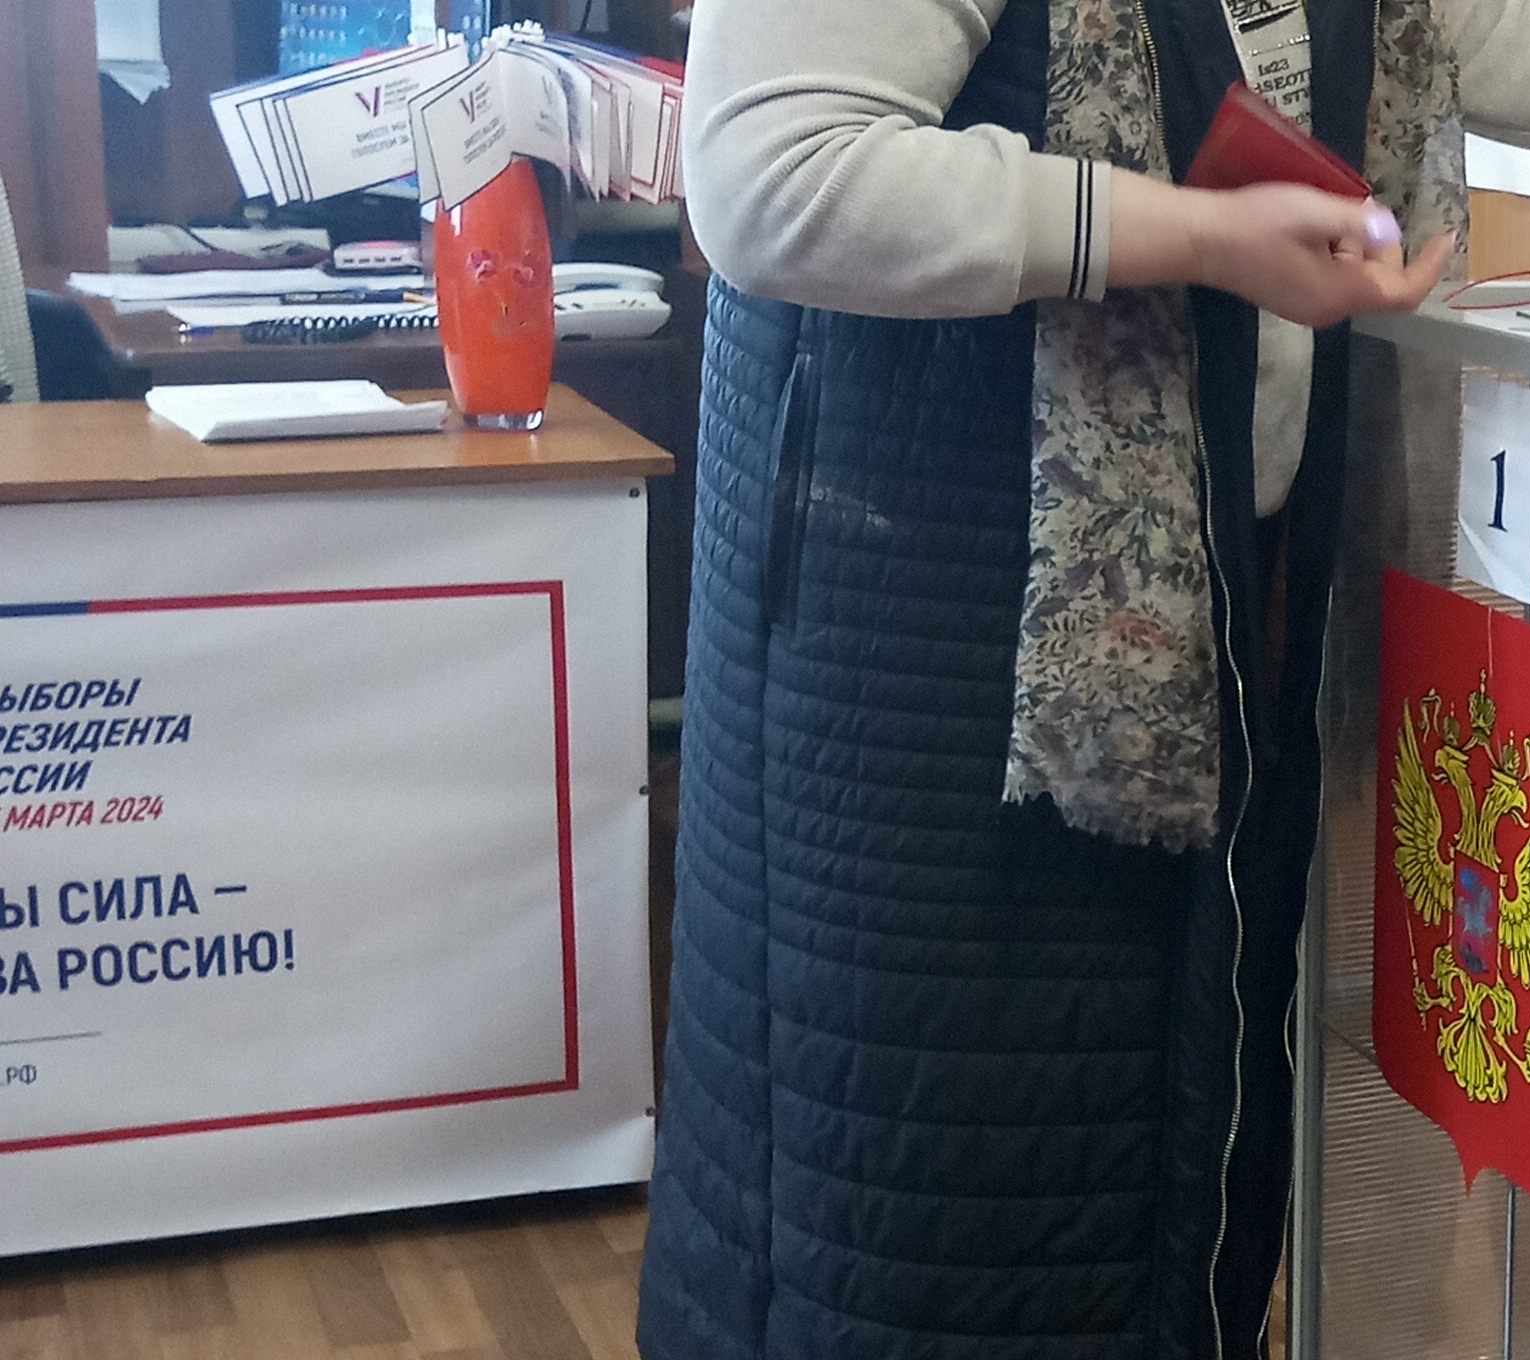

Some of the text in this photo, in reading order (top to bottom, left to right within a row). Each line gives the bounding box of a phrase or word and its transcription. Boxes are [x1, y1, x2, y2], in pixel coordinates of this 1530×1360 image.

[1487, 449, 1508, 533] 1
[3, 794, 164, 833] МАРТА 2024
[58, 872, 200, 926] СИЛА
[57, 928, 295, 991] РОССИЮ!
